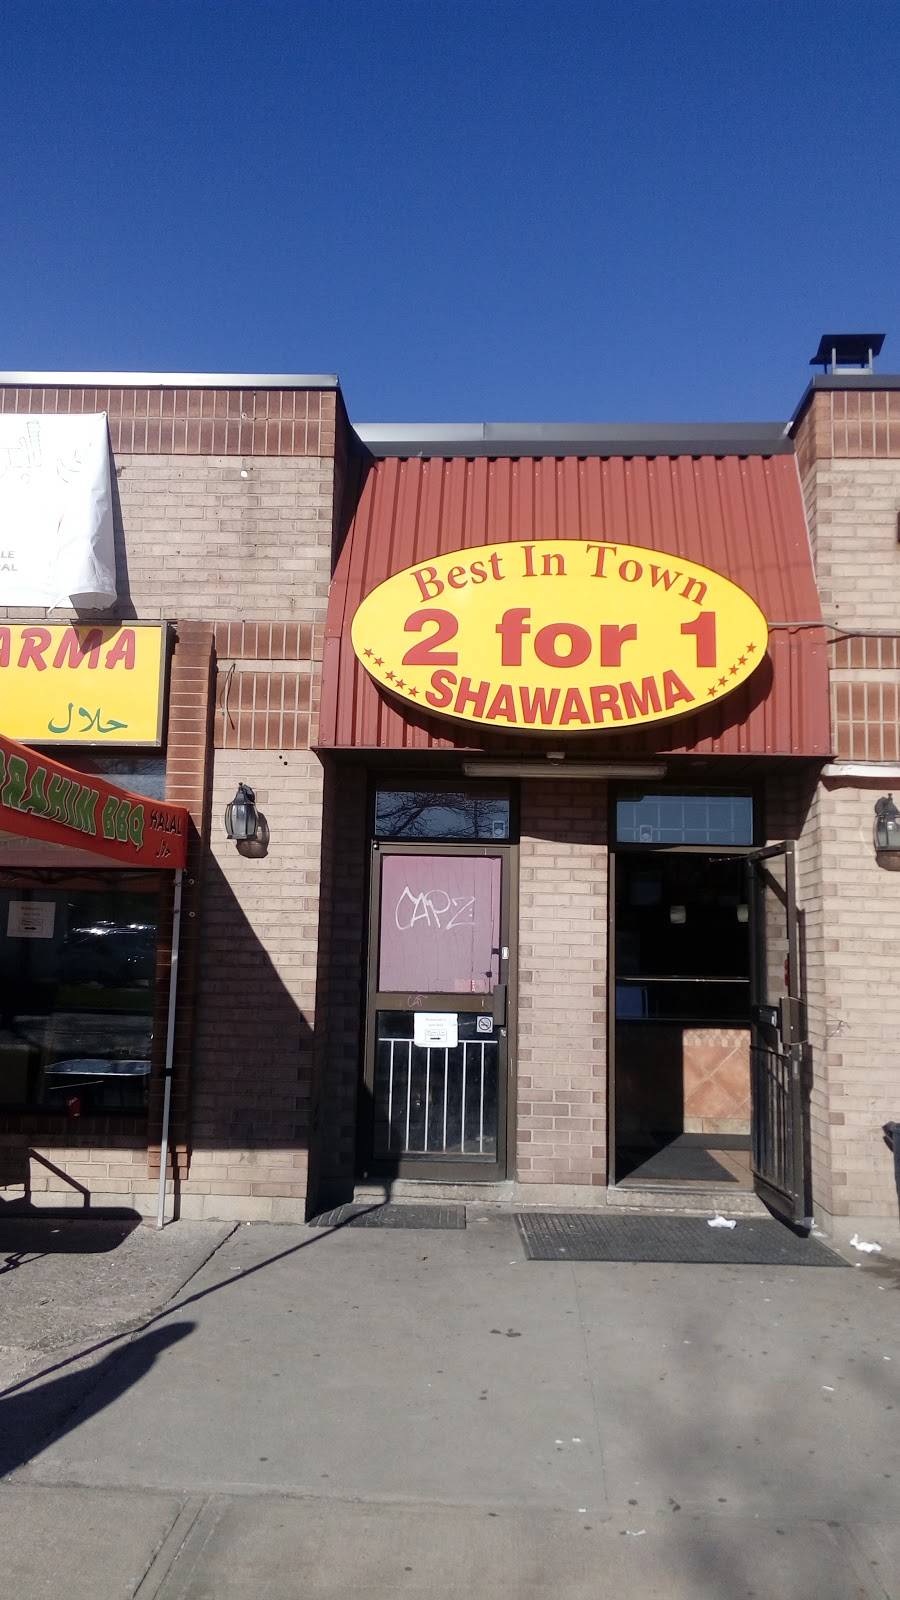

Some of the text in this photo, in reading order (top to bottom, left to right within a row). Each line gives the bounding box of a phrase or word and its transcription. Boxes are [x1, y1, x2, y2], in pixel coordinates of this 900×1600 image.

[409, 543, 709, 606] Best In Town
[401, 607, 717, 669] 2 for 1
[47, 702, 129, 734] حلال
[424, 669, 695, 726] SHAWARMA
[0, 748, 145, 852] RAHIM BBQ
